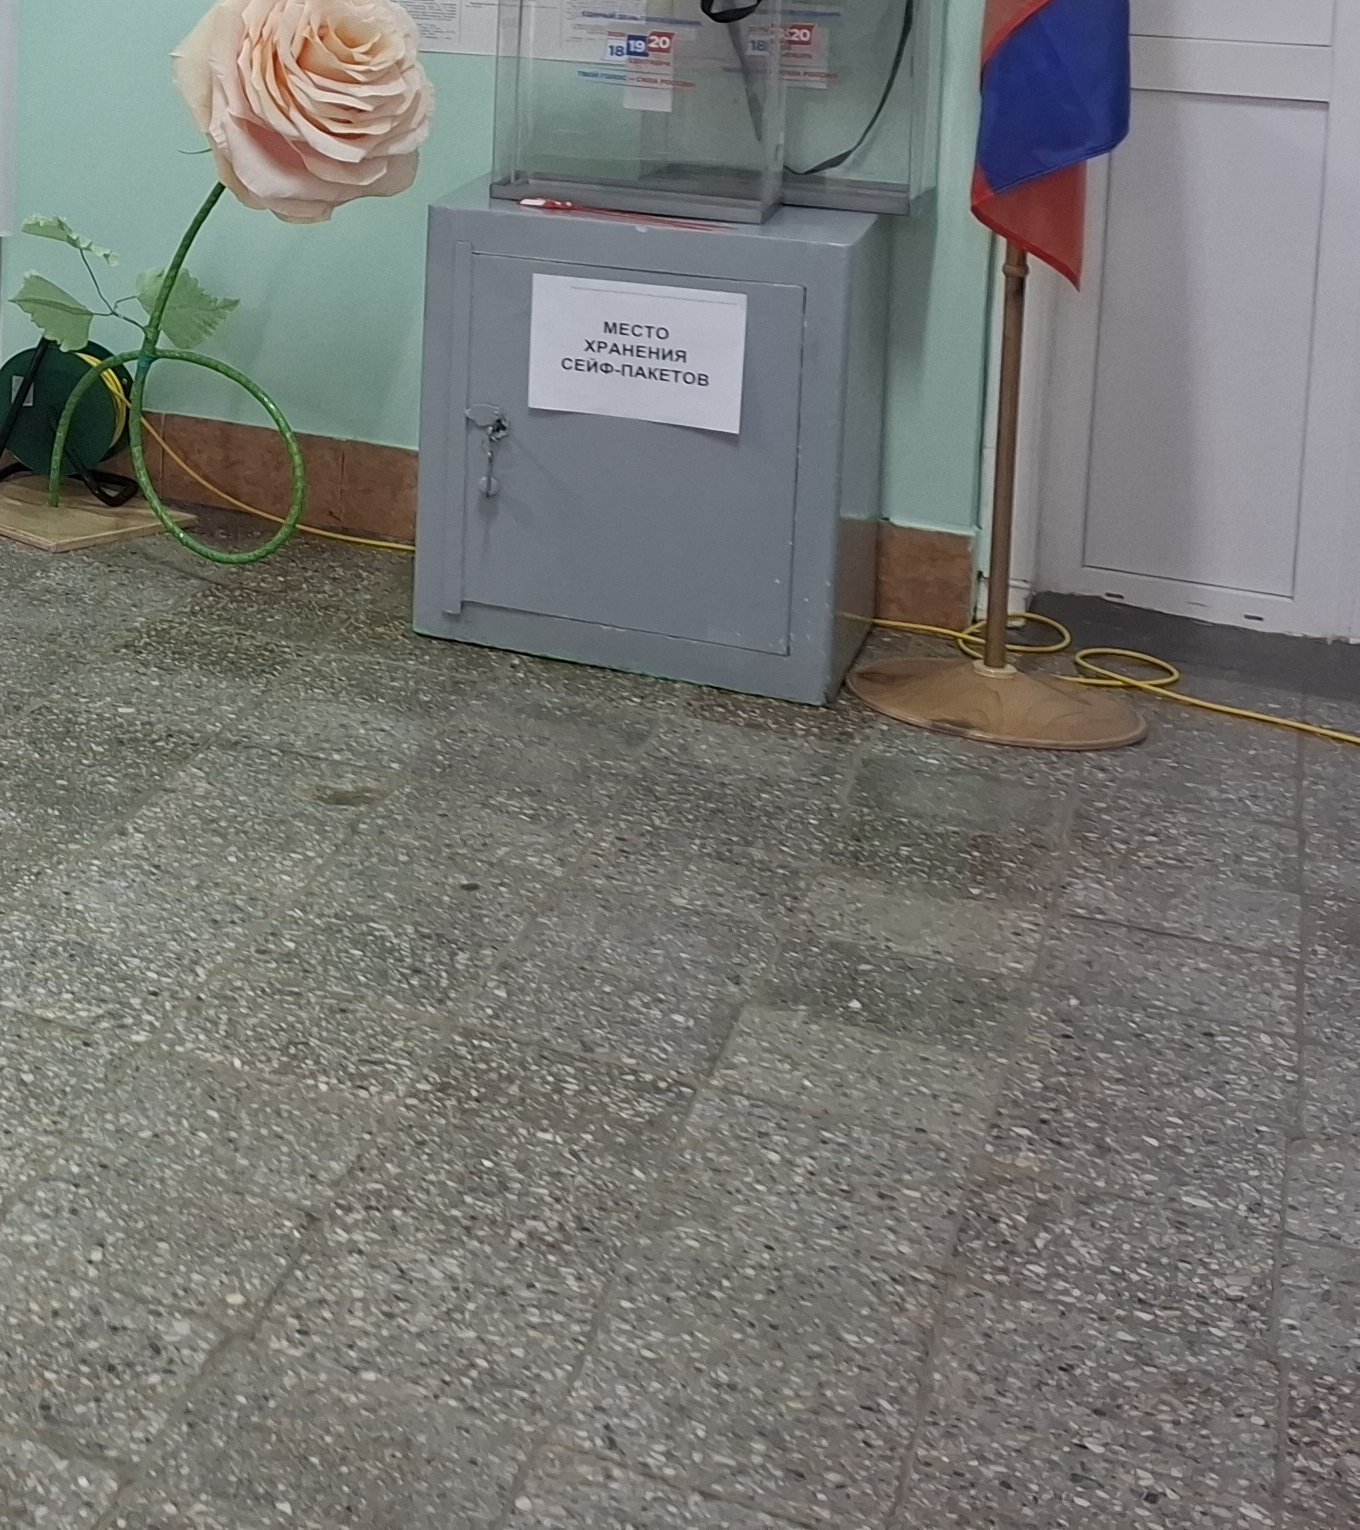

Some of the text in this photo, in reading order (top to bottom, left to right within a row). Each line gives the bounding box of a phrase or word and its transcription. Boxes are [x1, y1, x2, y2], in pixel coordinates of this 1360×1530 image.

[628, 40, 646, 52] 19
[648, 35, 670, 49] 20
[608, 45, 625, 57] 18
[603, 321, 670, 340] МЕСТО
[584, 339, 687, 363] ХРАНЕНИЯ
[561, 357, 710, 387] СЕЙФ-ПАКЕТОВ
